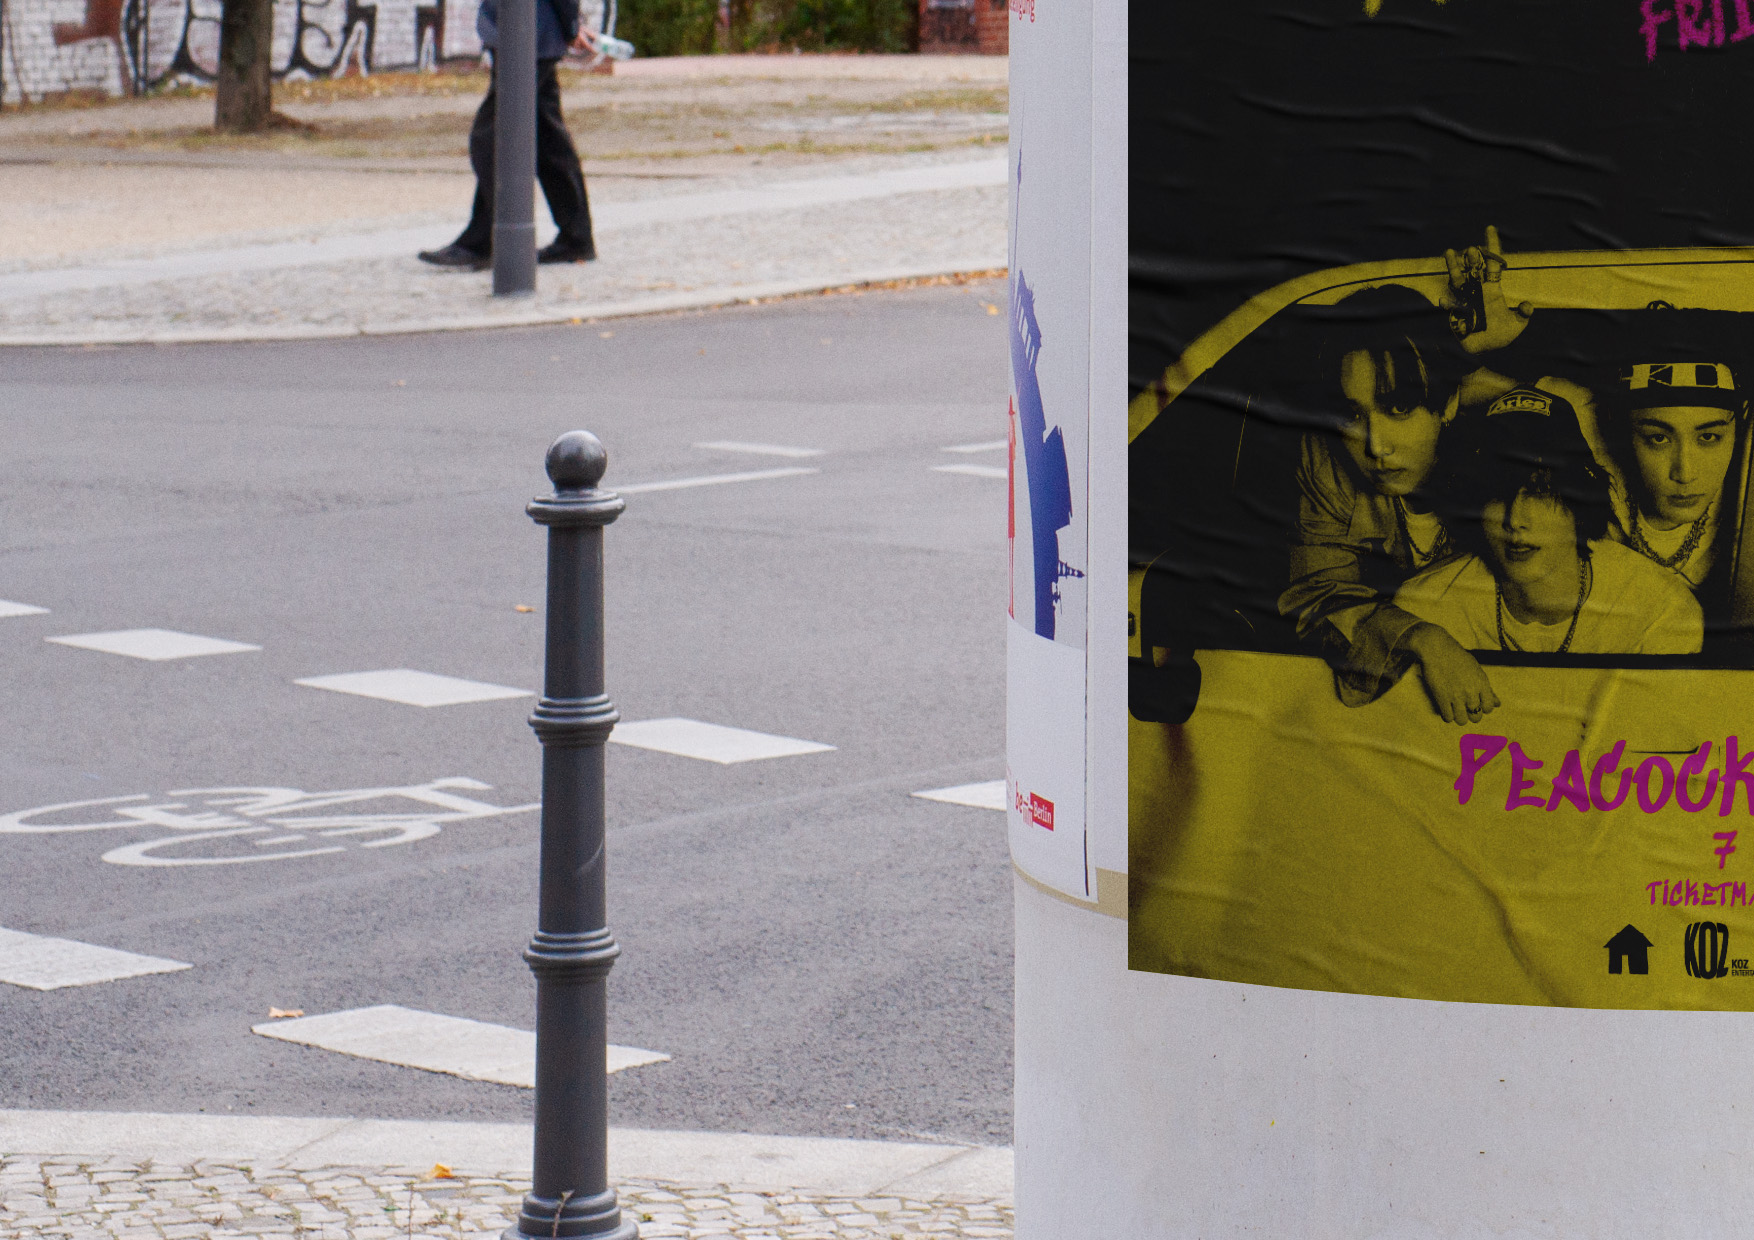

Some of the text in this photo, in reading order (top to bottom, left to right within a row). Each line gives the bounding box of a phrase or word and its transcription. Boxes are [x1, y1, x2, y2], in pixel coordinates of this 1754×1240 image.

[1033, 801, 1052, 824] Berlin
[1713, 831, 1737, 869] 7
[1684, 921, 1729, 980] KOZ
[1731, 959, 1749, 969] KOZ
